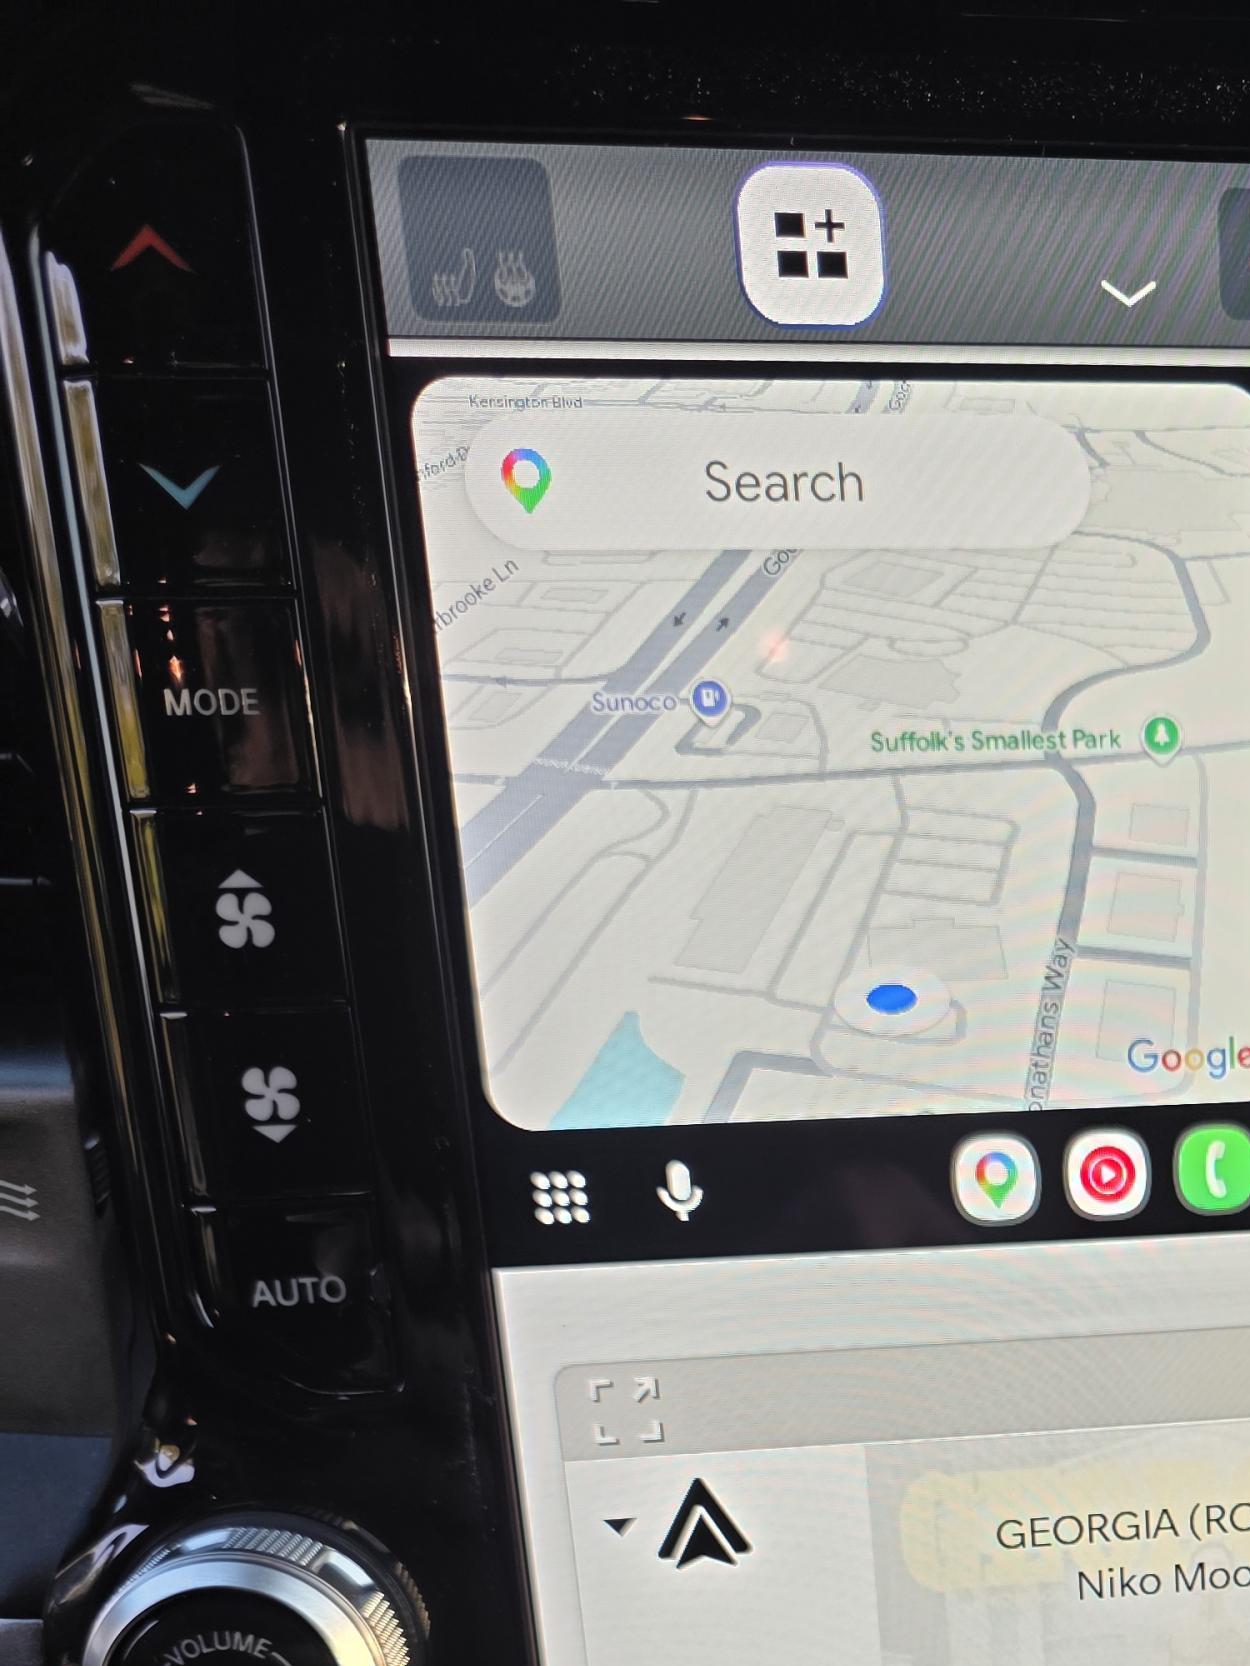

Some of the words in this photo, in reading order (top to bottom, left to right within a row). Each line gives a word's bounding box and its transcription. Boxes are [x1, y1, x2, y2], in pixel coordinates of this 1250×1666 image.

[468, 394, 549, 412] Kensington
[552, 396, 583, 409] Blvd
[706, 460, 863, 502] Search
[491, 559, 519, 583] Ln
[163, 688, 260, 717] MODE
[592, 691, 678, 714] Sunoco
[870, 730, 966, 752] Suffolk's
[971, 730, 1067, 751] Smallest
[1073, 729, 1122, 749] Park
[1042, 937, 1076, 992] Way
[252, 1276, 347, 1308] AUTO
[996, 1507, 1181, 1550] GEORGIA
[1077, 1567, 1162, 1601] Niko
